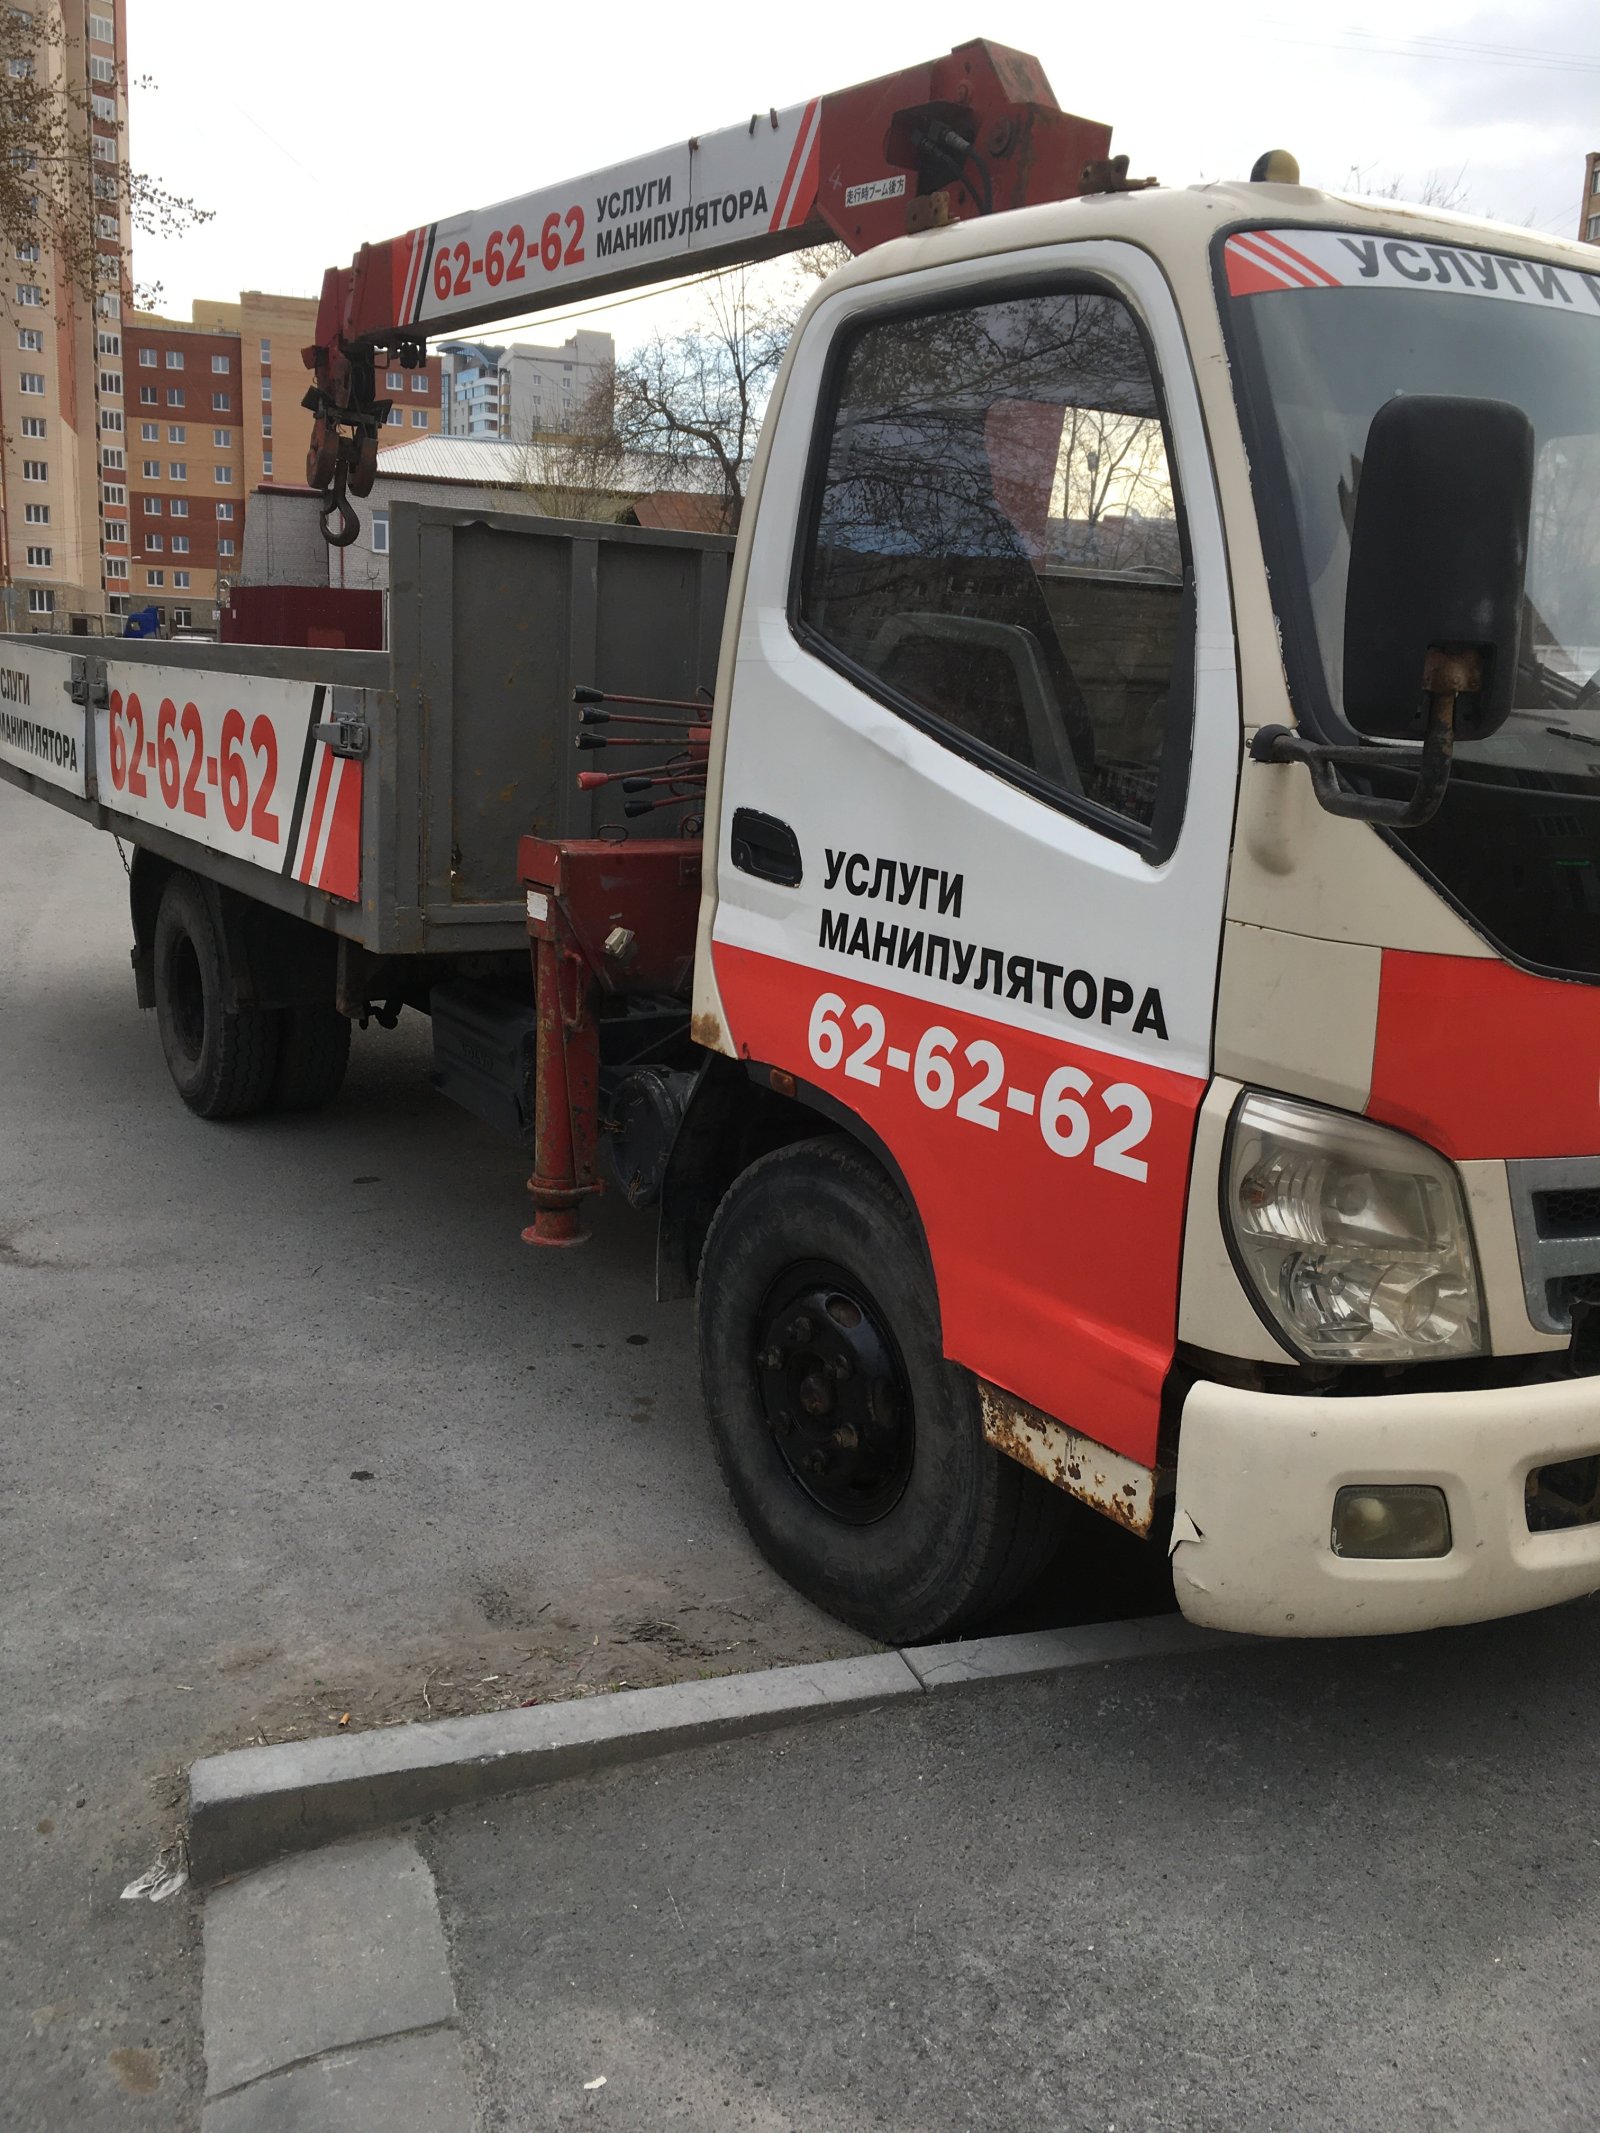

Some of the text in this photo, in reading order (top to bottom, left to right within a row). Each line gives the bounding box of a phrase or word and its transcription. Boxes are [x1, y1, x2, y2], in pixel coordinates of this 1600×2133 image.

[596, 175, 672, 223] УСЛУГИ
[596, 185, 769, 258] МАНИПУЛЯТОРА
[847, 177, 905, 204] 走行時ブーム後方
[433, 205, 585, 301] 62-62-62
[1336, 237, 1574, 304] УСЛУГИ
[0, 667, 31, 706] СЛУГИ
[108, 688, 279, 845] 62-62-62
[823, 848, 965, 919] УСЛУГИ
[818, 908, 1170, 1041] МАНИПУЛЯТОРА
[807, 991, 1154, 1184] 62-62-62
